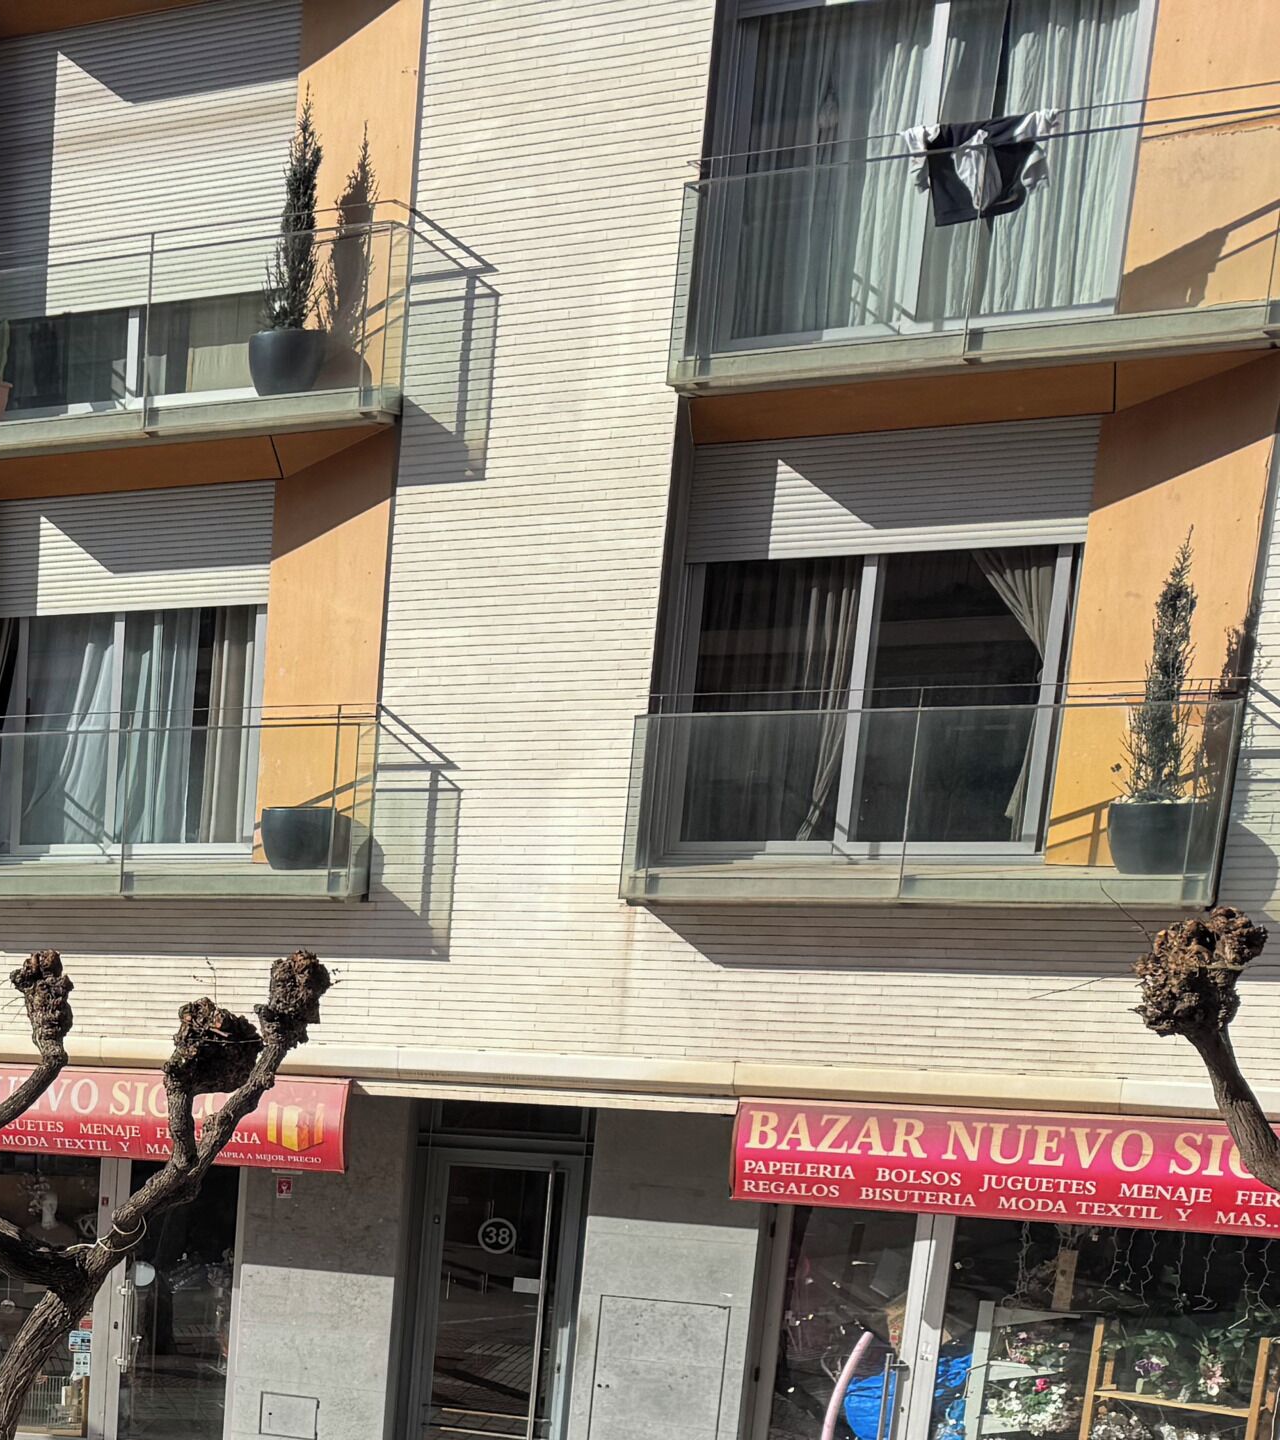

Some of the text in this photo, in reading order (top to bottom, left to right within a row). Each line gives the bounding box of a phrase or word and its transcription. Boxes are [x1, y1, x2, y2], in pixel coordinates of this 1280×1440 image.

[4, 1118, 65, 1133] GUETES
[80, 1123, 141, 1138] MENAJE
[744, 1110, 928, 1159] BAZAR
[941, 1120, 1154, 1172] NUEVO
[2, 1135, 49, 1148] MODA
[53, 1137, 112, 1151] TEXTIL
[118, 1142, 131, 1153] Y
[255, 1154, 285, 1162] MEJOR
[287, 1156, 322, 1164] PRECIO
[743, 1159, 856, 1180] PAPELERIA
[875, 1167, 962, 1186] BOLSOS
[979, 1174, 1097, 1195] JUGUETES
[1119, 1182, 1213, 1206] MENAJE
[743, 1179, 840, 1198] REGALOS
[859, 1187, 976, 1207] BISUTERIA
[998, 1196, 1068, 1214] MODA
[1076, 1201, 1163, 1220] TEXTIL
[1175, 1208, 1192, 1222] Y
[485, 1226, 510, 1245] 38
